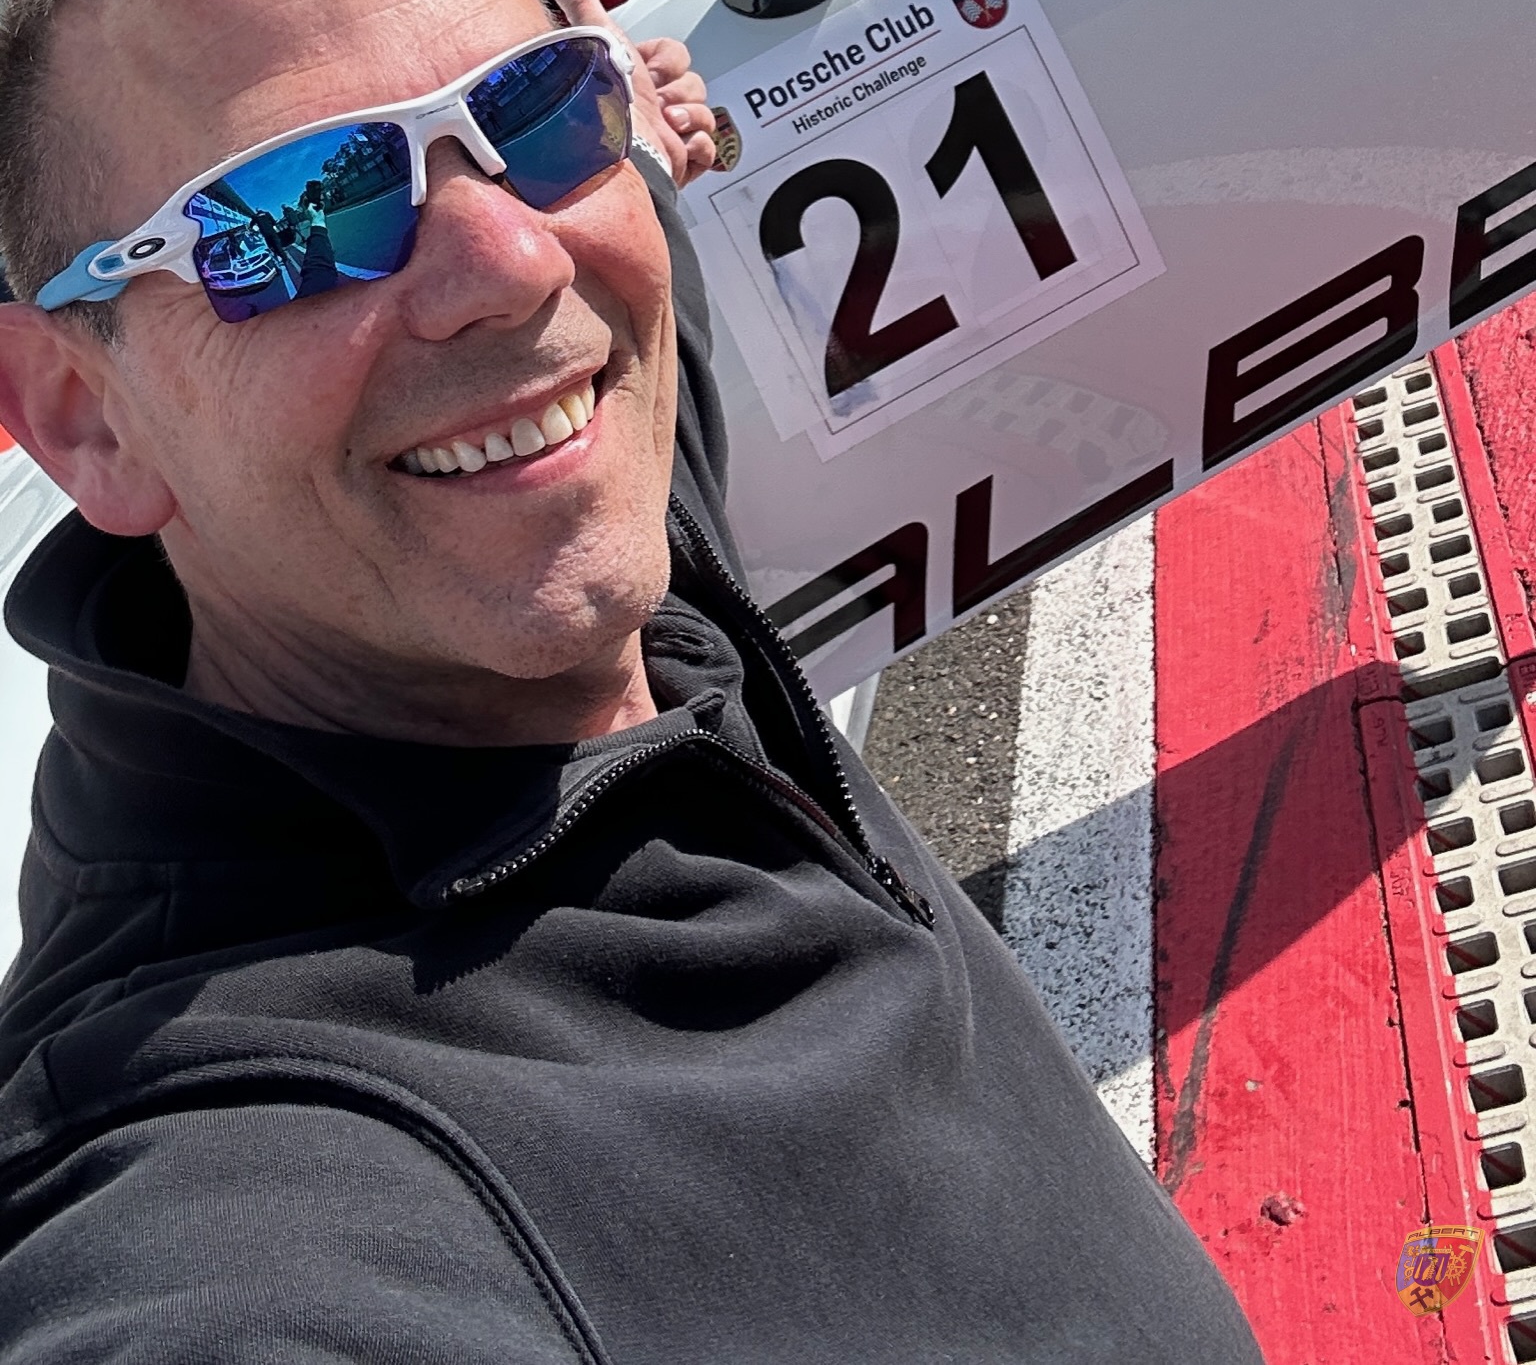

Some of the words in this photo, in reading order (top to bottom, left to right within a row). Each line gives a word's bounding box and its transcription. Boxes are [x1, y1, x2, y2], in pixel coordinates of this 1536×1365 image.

[744, 43, 866, 120] Porsche
[865, 4, 935, 53] Club
[792, 96, 853, 134] Historic
[852, 56, 927, 102] Challenge
[759, 70, 1077, 399] 21
